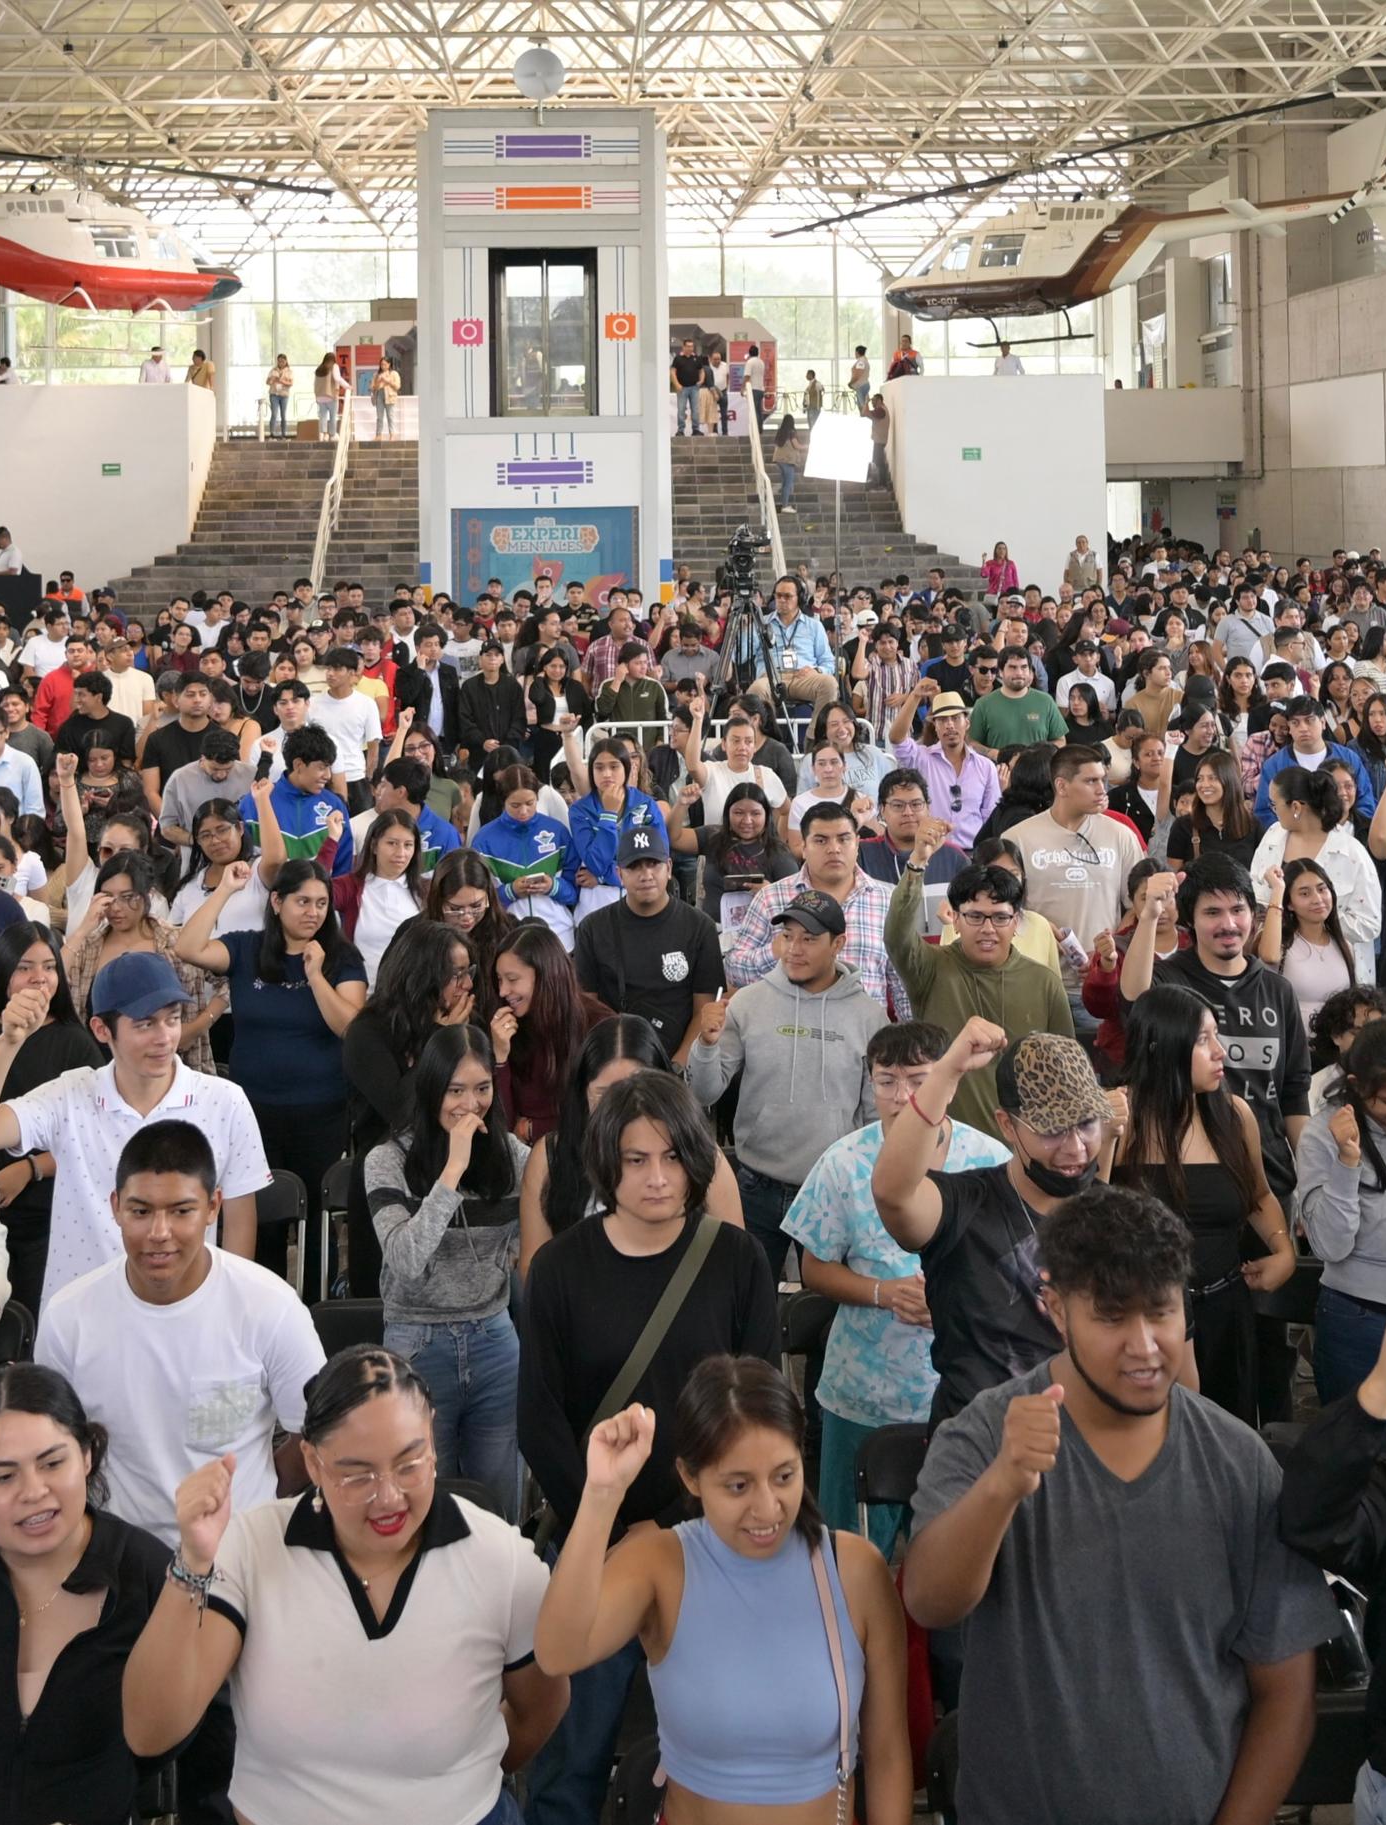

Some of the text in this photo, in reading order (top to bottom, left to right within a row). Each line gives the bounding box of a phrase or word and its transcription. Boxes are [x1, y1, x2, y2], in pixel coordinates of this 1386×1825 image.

[511, 527, 579, 540] EXPERI
[507, 541, 583, 552] MENTALES
[633, 832, 650, 849] NY
[662, 951, 686, 966] VANS
